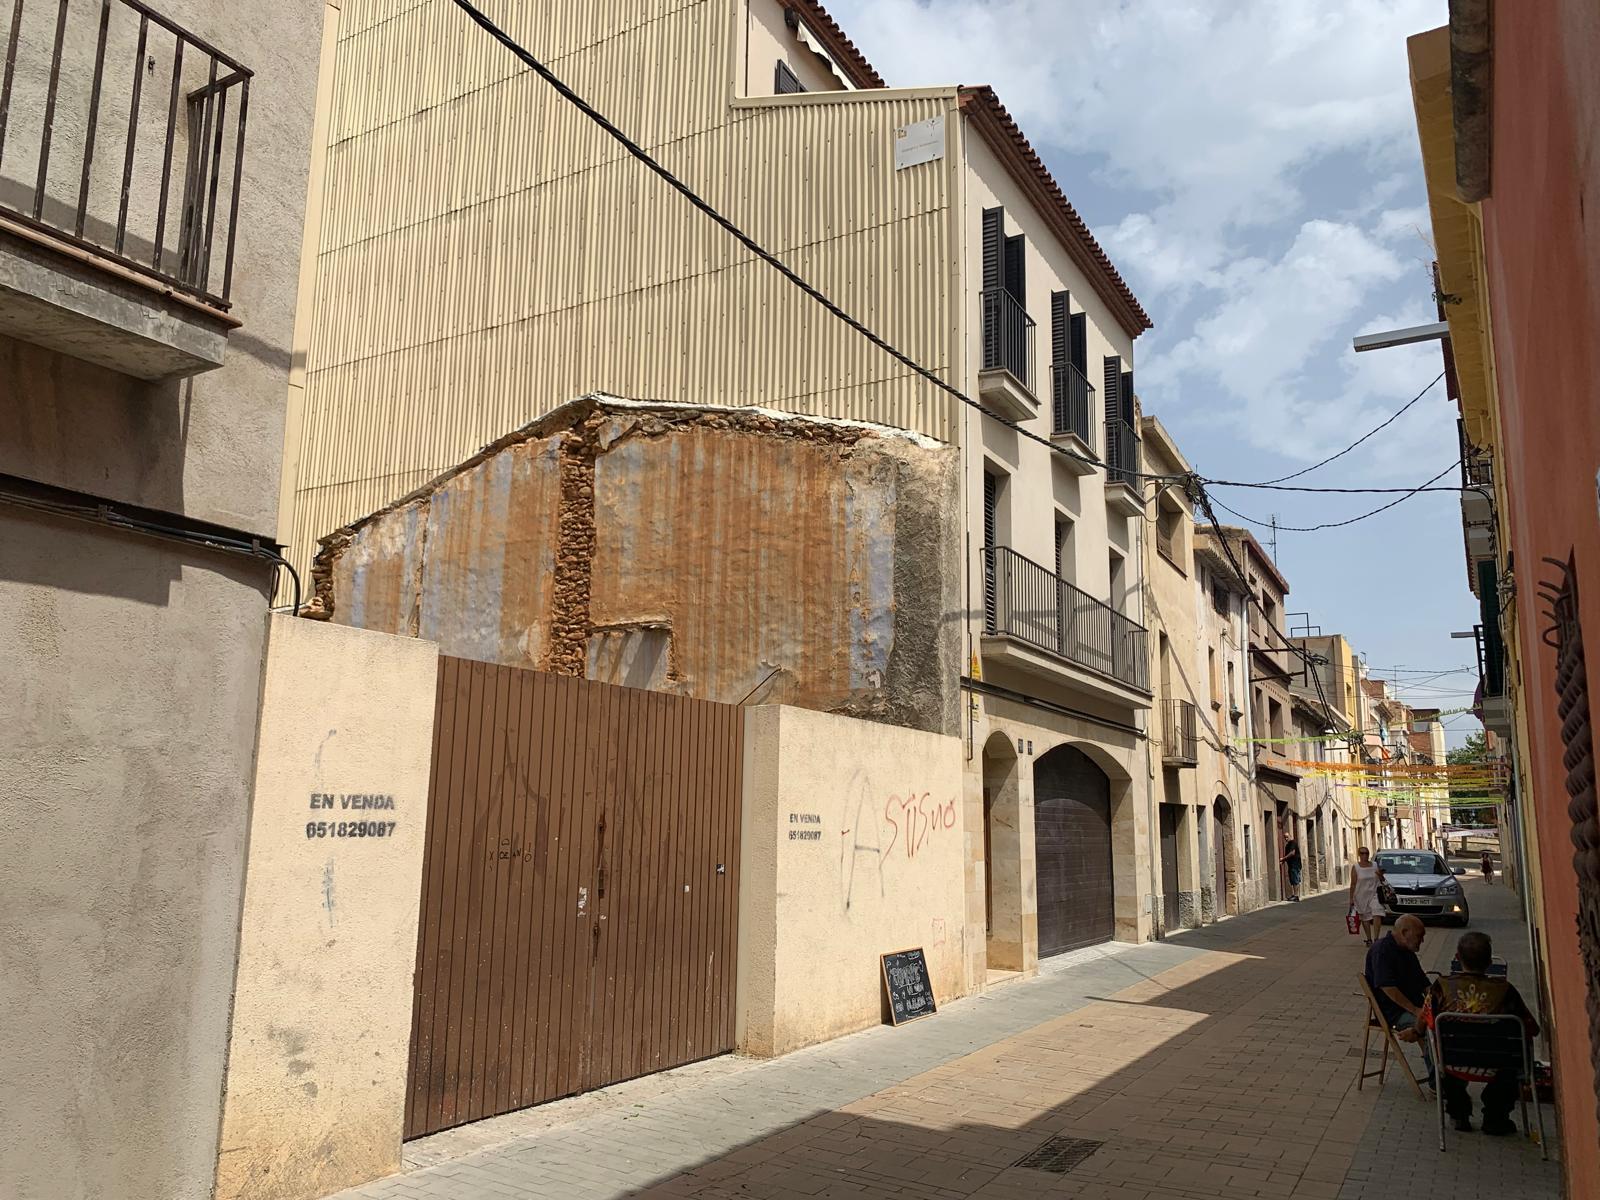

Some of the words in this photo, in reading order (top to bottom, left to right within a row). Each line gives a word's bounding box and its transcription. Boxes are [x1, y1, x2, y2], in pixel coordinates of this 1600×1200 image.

[309, 793, 334, 809] EN
[340, 794, 395, 810] VENDA
[789, 813, 798, 823] EN
[800, 814, 821, 824] VENDA
[306, 821, 396, 839] 651829087
